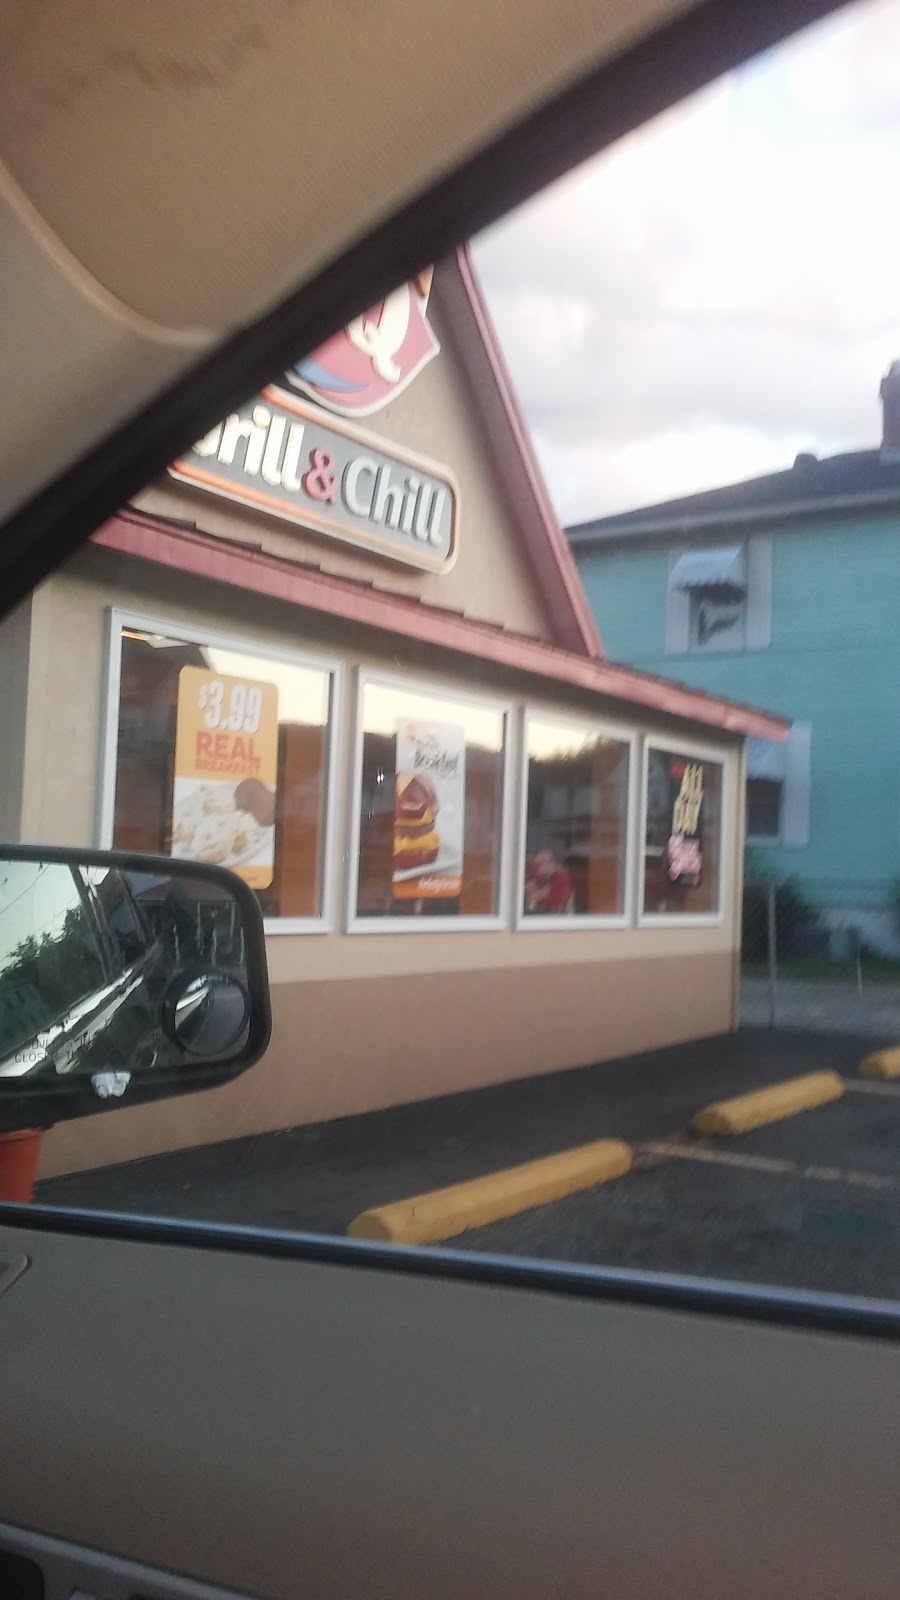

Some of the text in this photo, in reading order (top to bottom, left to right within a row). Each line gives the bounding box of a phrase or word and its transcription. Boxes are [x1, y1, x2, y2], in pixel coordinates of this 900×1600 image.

[302, 447, 338, 504] &
[343, 454, 446, 546] Chill
[198, 680, 263, 734] $3.99
[195, 730, 262, 765] REAL
